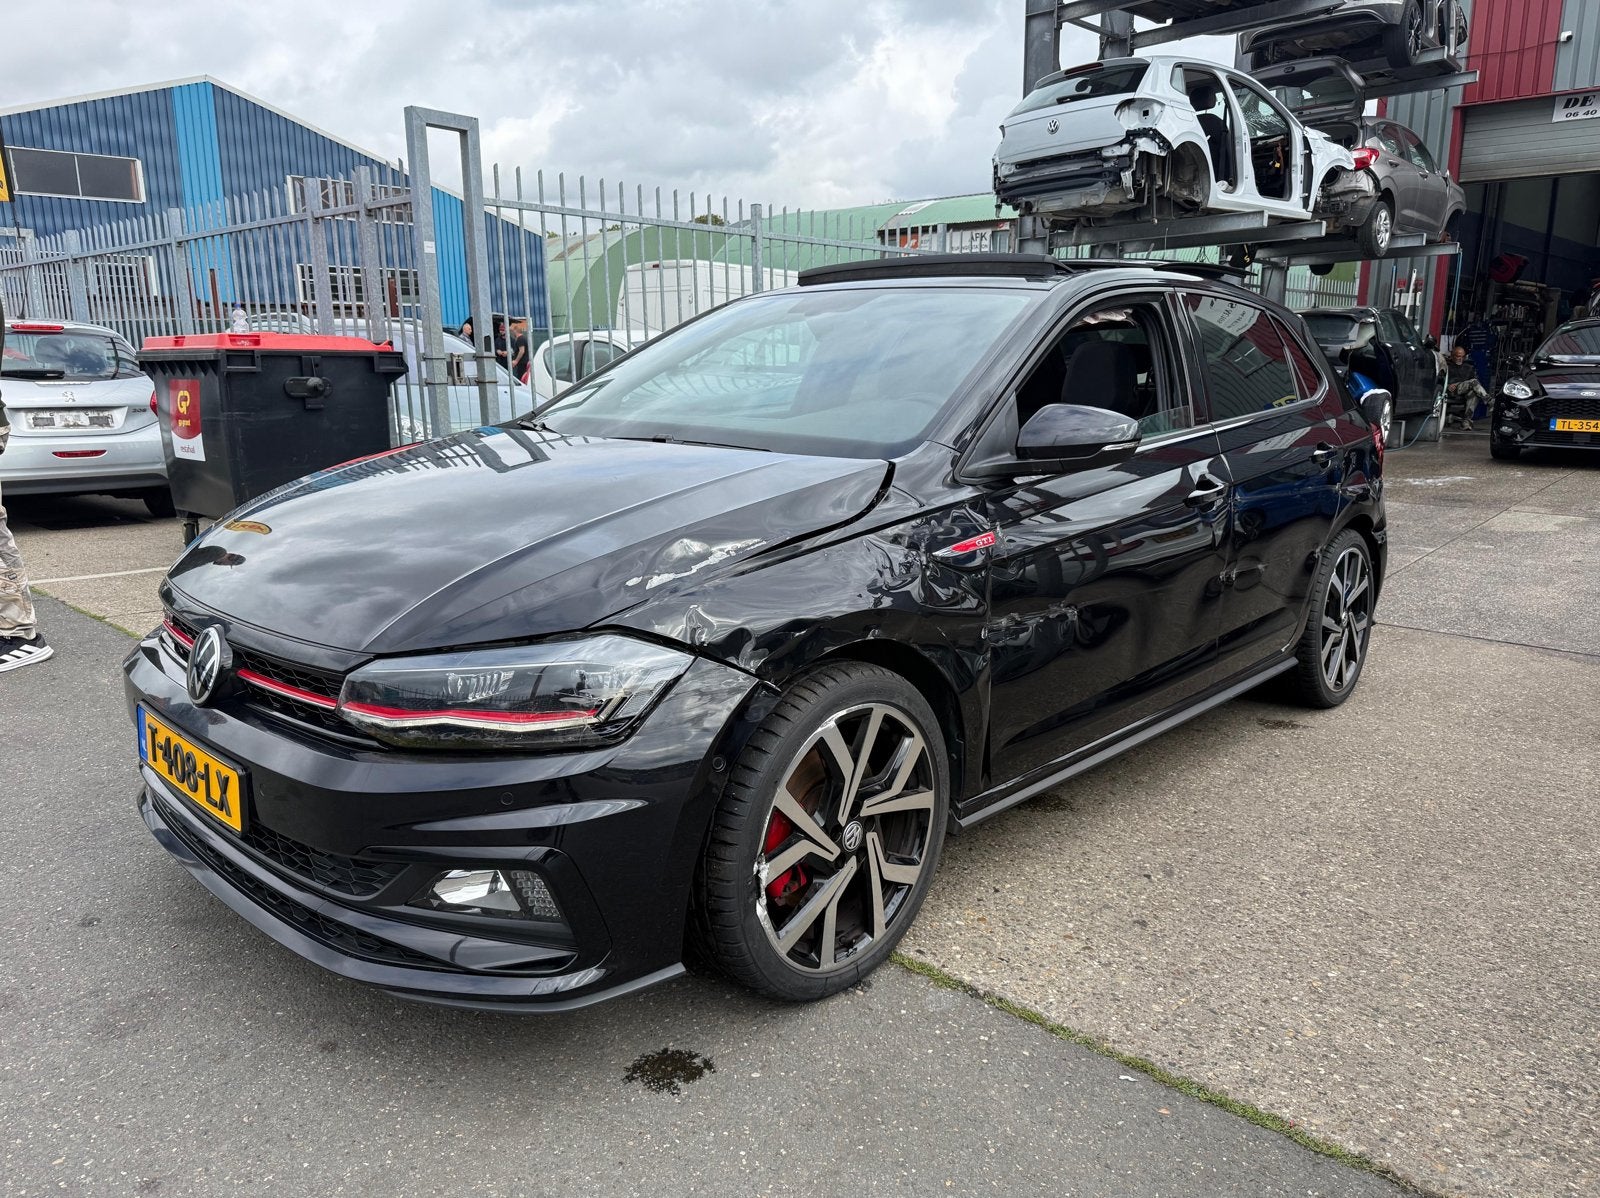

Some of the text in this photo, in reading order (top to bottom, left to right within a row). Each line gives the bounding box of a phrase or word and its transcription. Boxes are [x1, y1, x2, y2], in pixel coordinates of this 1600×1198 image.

[1563, 95, 1597, 109] DE
[1561, 420, 1600, 431] TL-354
[976, 536, 993, 547] GTI
[148, 722, 232, 817] T-408-LX
